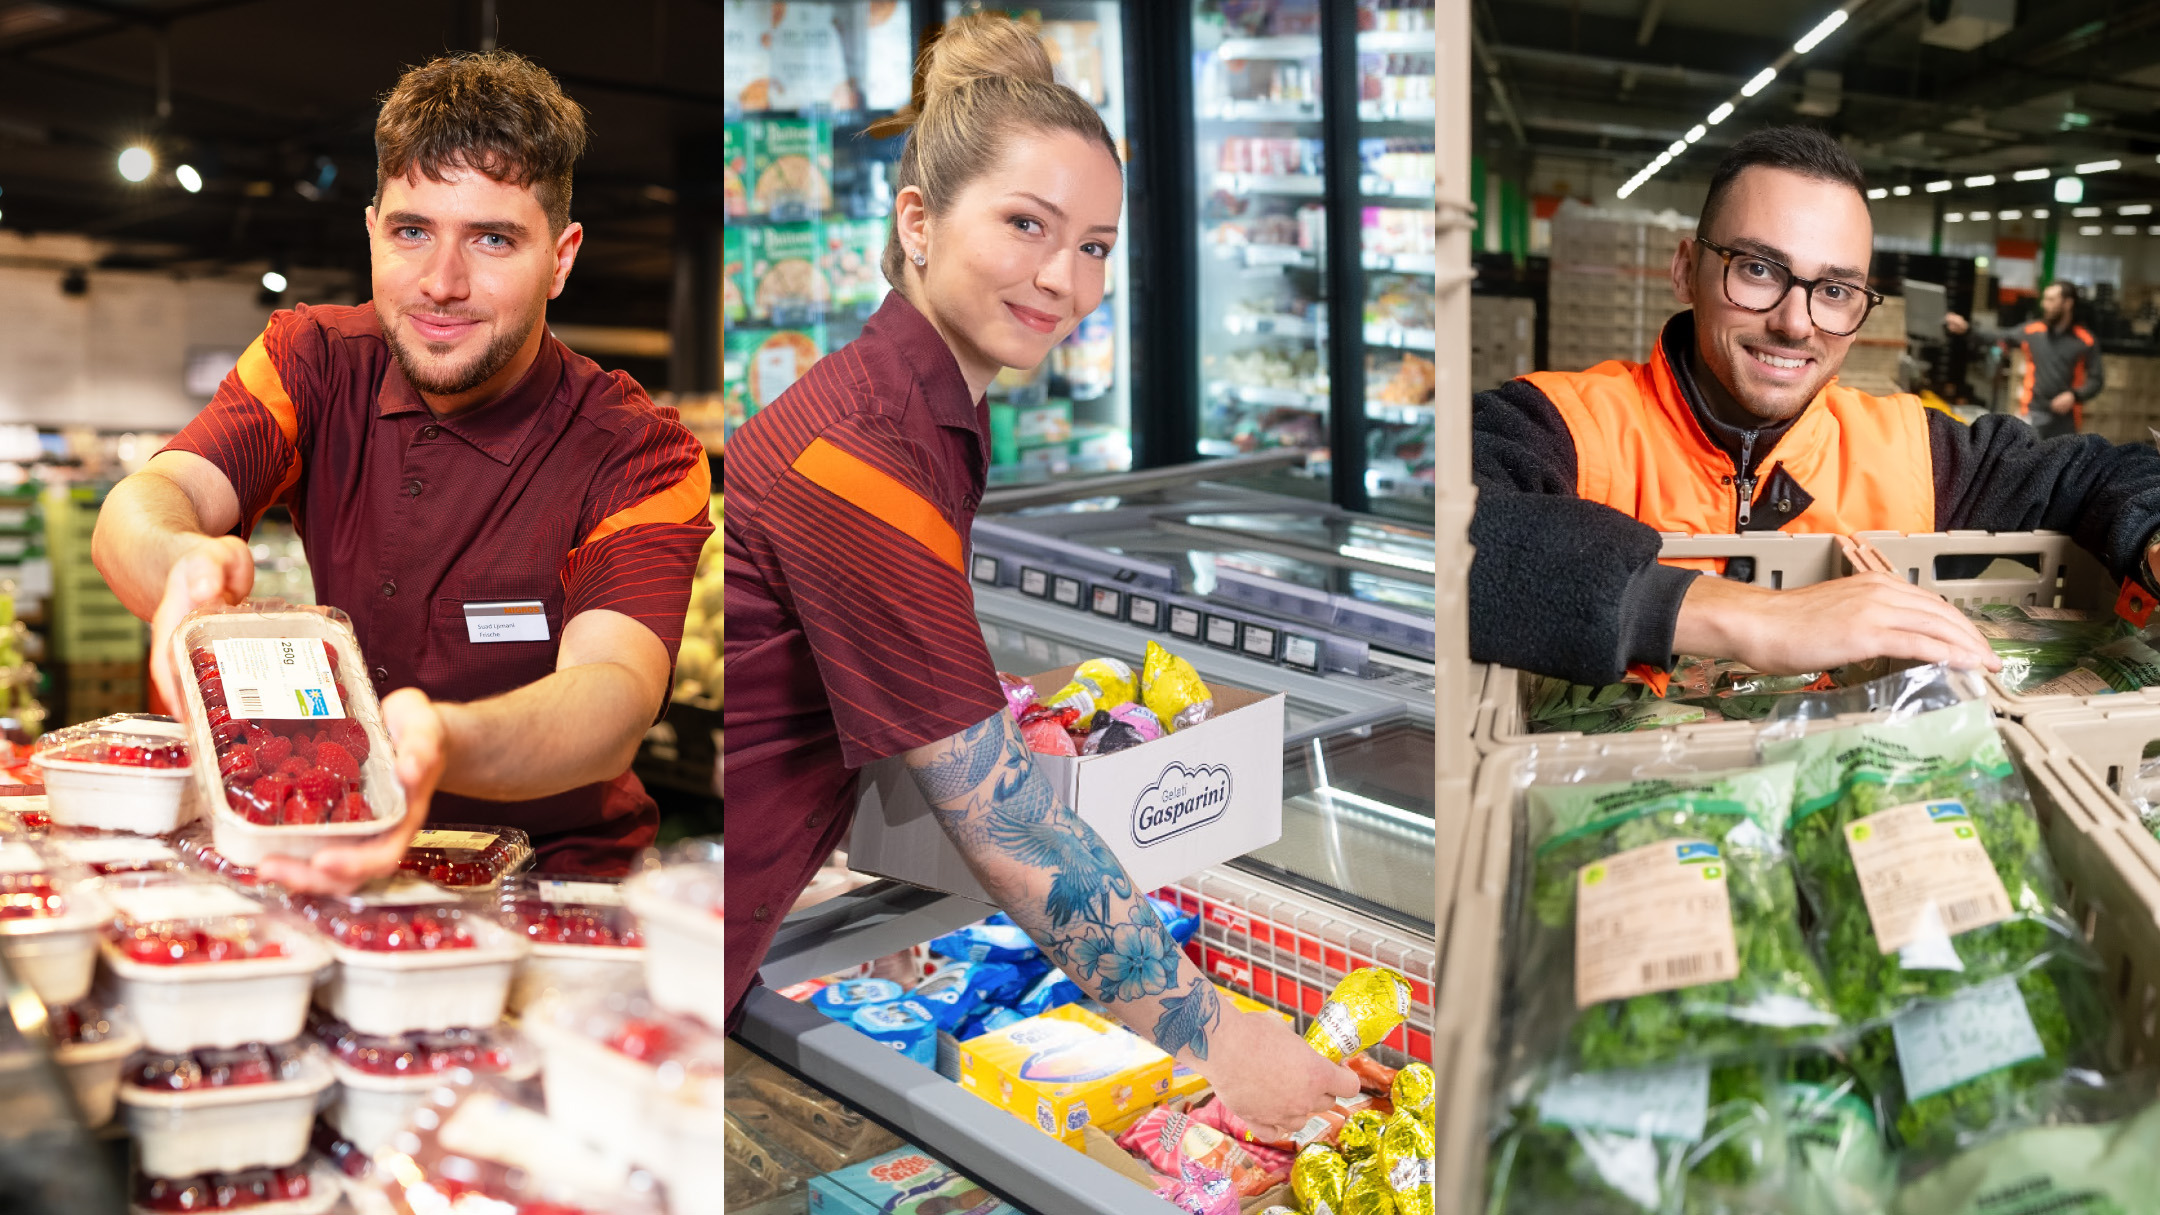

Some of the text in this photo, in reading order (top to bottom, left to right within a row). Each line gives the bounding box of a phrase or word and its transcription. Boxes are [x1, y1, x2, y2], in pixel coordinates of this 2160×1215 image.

[504, 606, 540, 615] MIGROS
[281, 641, 296, 665] 250g
[1161, 782, 1188, 804] Gelati
[1139, 780, 1226, 831] Gasparini
[1162, 1078, 1169, 1089] 6
